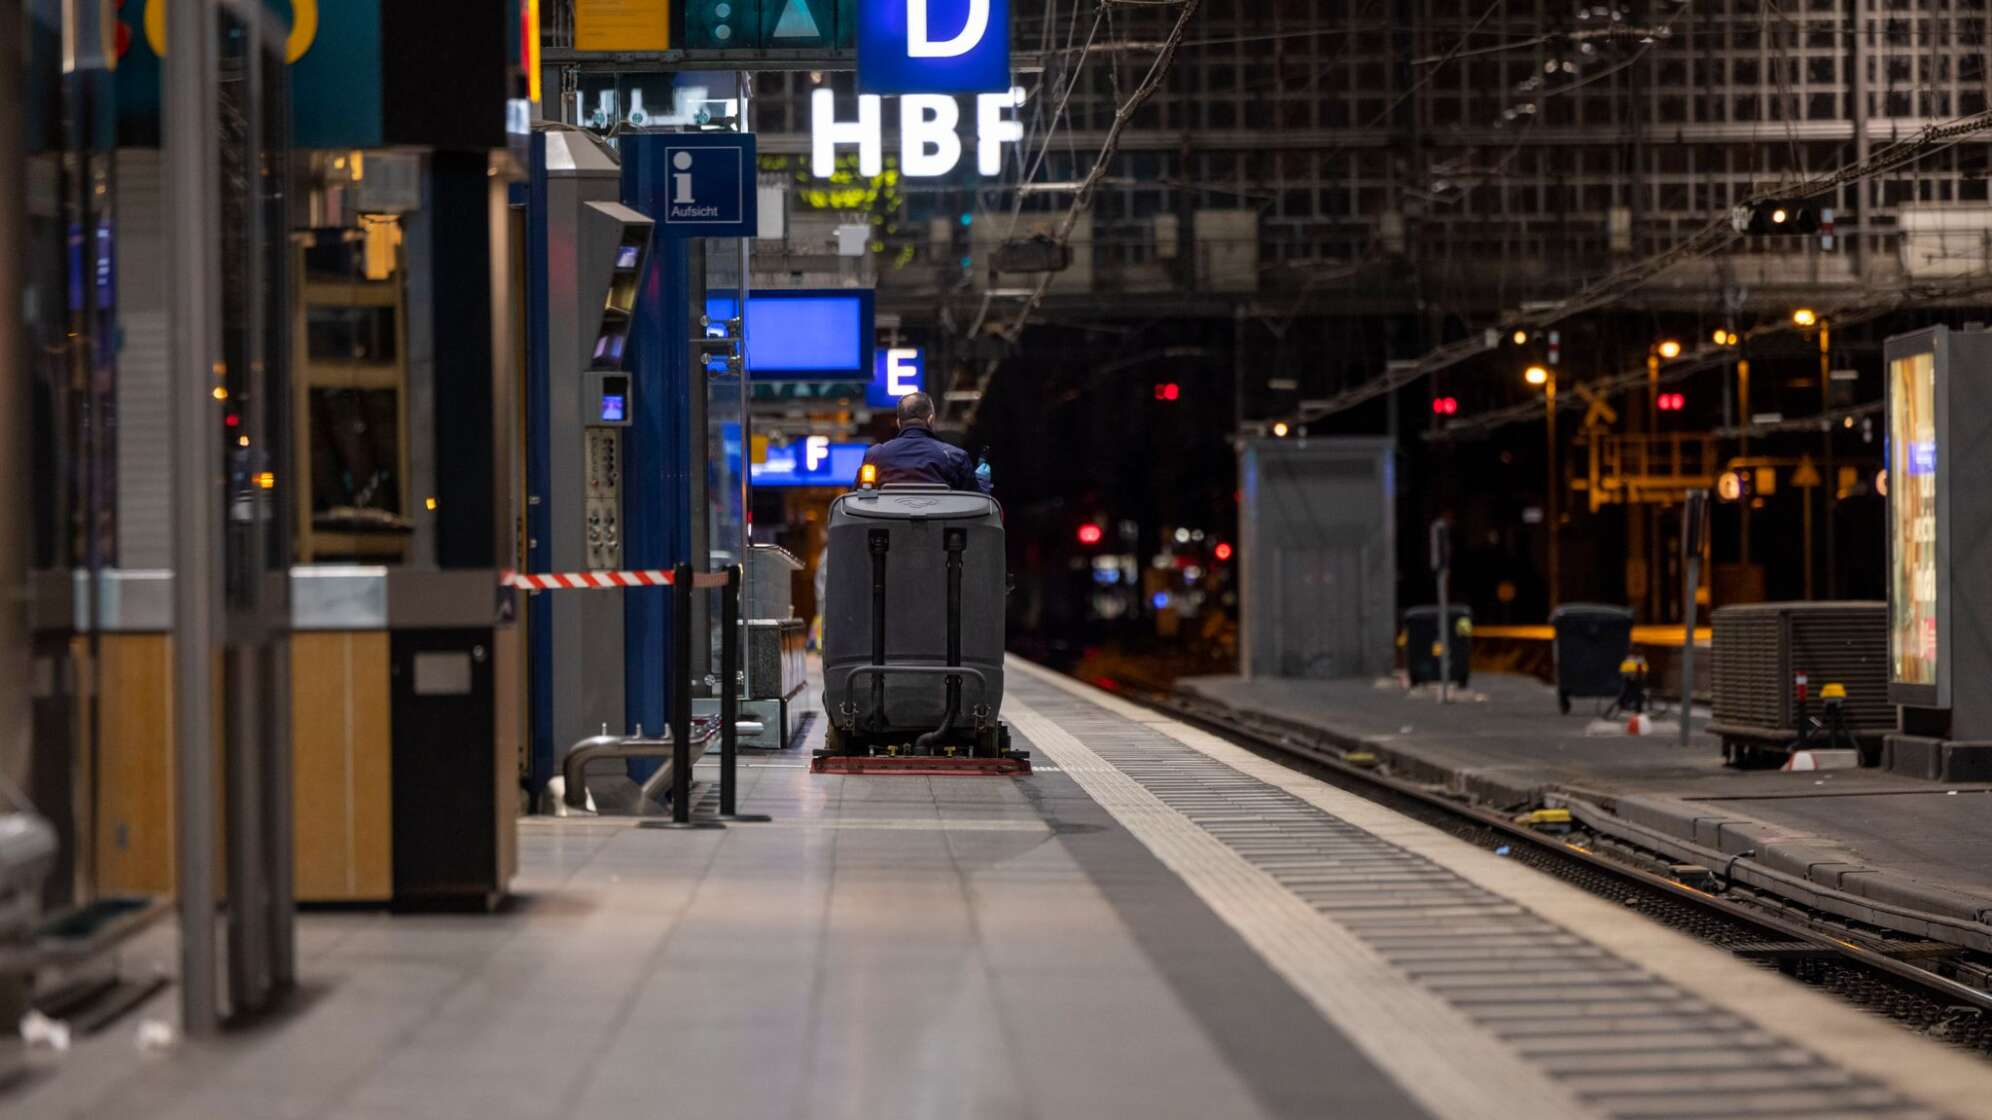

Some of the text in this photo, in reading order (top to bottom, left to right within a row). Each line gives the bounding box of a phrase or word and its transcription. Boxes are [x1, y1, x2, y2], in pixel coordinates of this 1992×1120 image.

[907, 0, 990, 57] D
[812, 86, 1026, 177] HBF
[671, 206, 718, 217] Aufsicht
[887, 348, 918, 396] E
[806, 436, 829, 471] F
